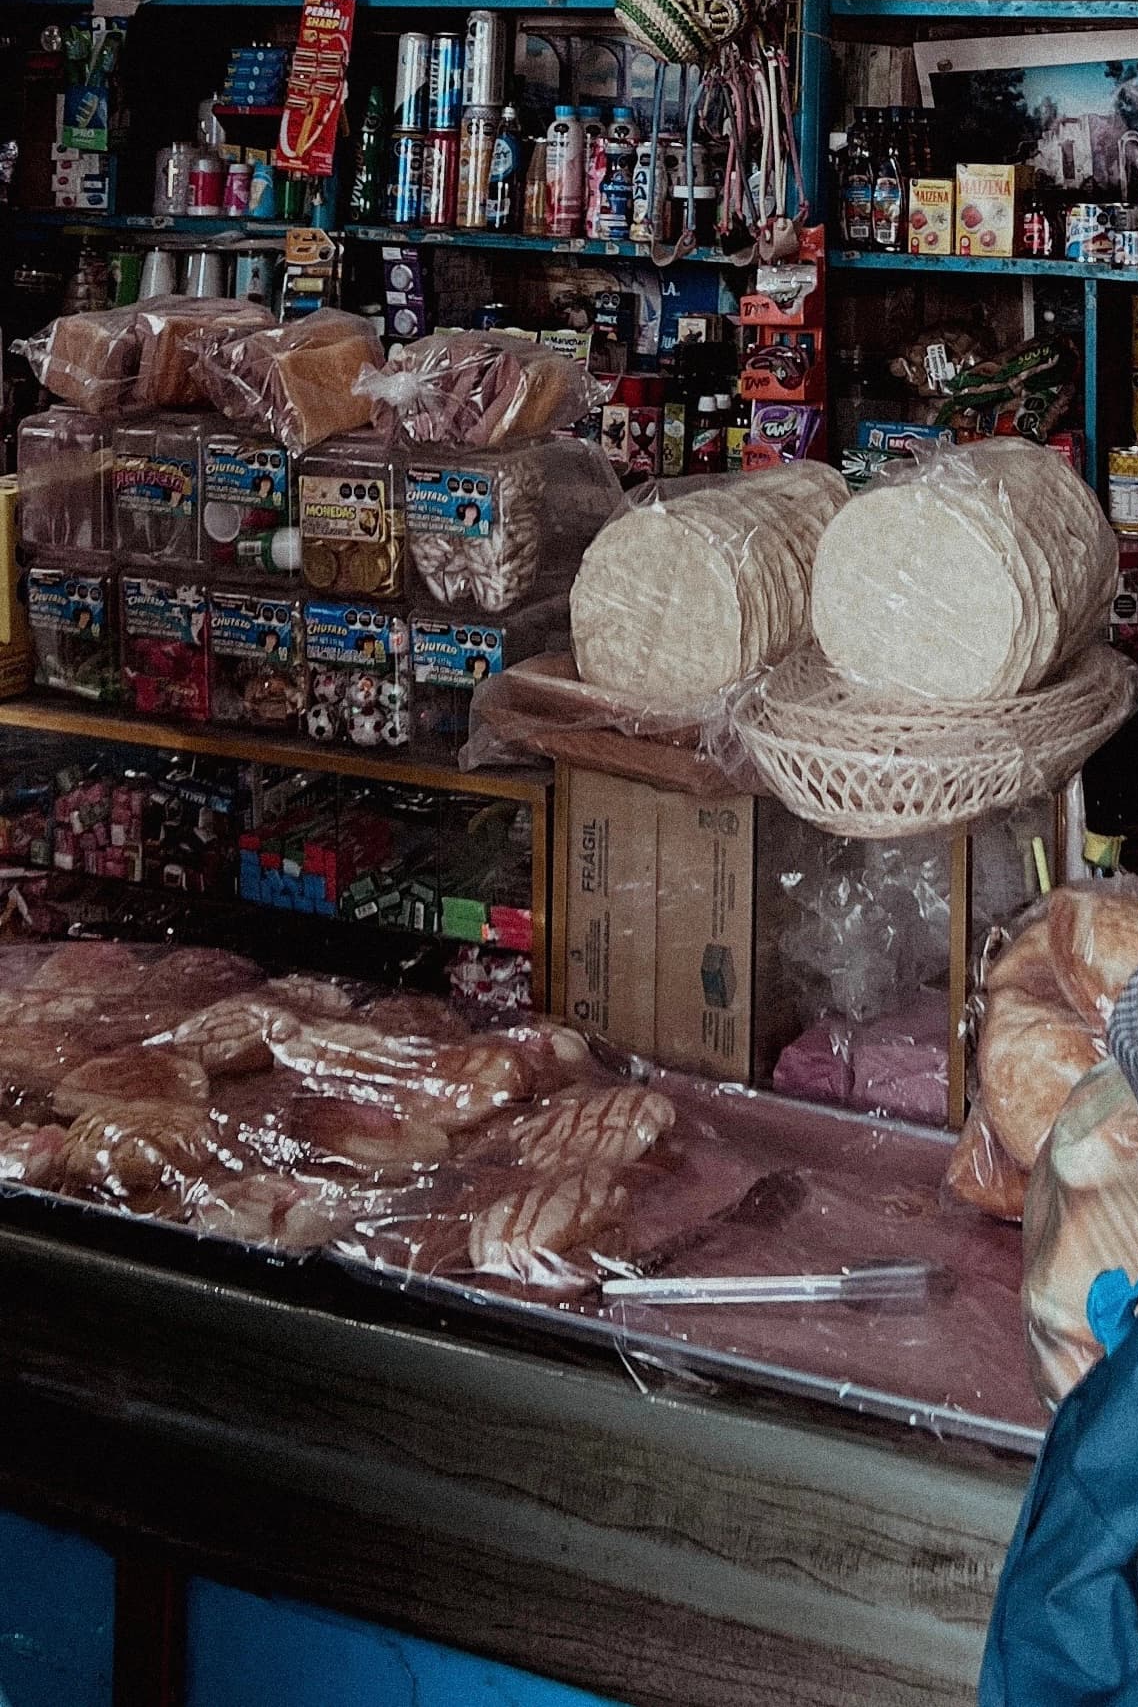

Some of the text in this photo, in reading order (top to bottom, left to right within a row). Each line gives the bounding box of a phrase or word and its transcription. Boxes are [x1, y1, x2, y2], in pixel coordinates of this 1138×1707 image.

[305, 6, 341, 19] PERMA
[306, 17, 340, 29] SHARP
[958, 180, 1011, 196] MAIZENA
[914, 190, 949, 202] MAIZENA
[405, 491, 448, 503] CHUTAZO
[304, 503, 357, 520] MONEDAS
[211, 616, 251, 629] CHUTAZO
[307, 624, 348, 637] CHUTAZO
[413, 642, 458, 655] CHUTAZO
[578, 818, 598, 893] FRÁGIL
